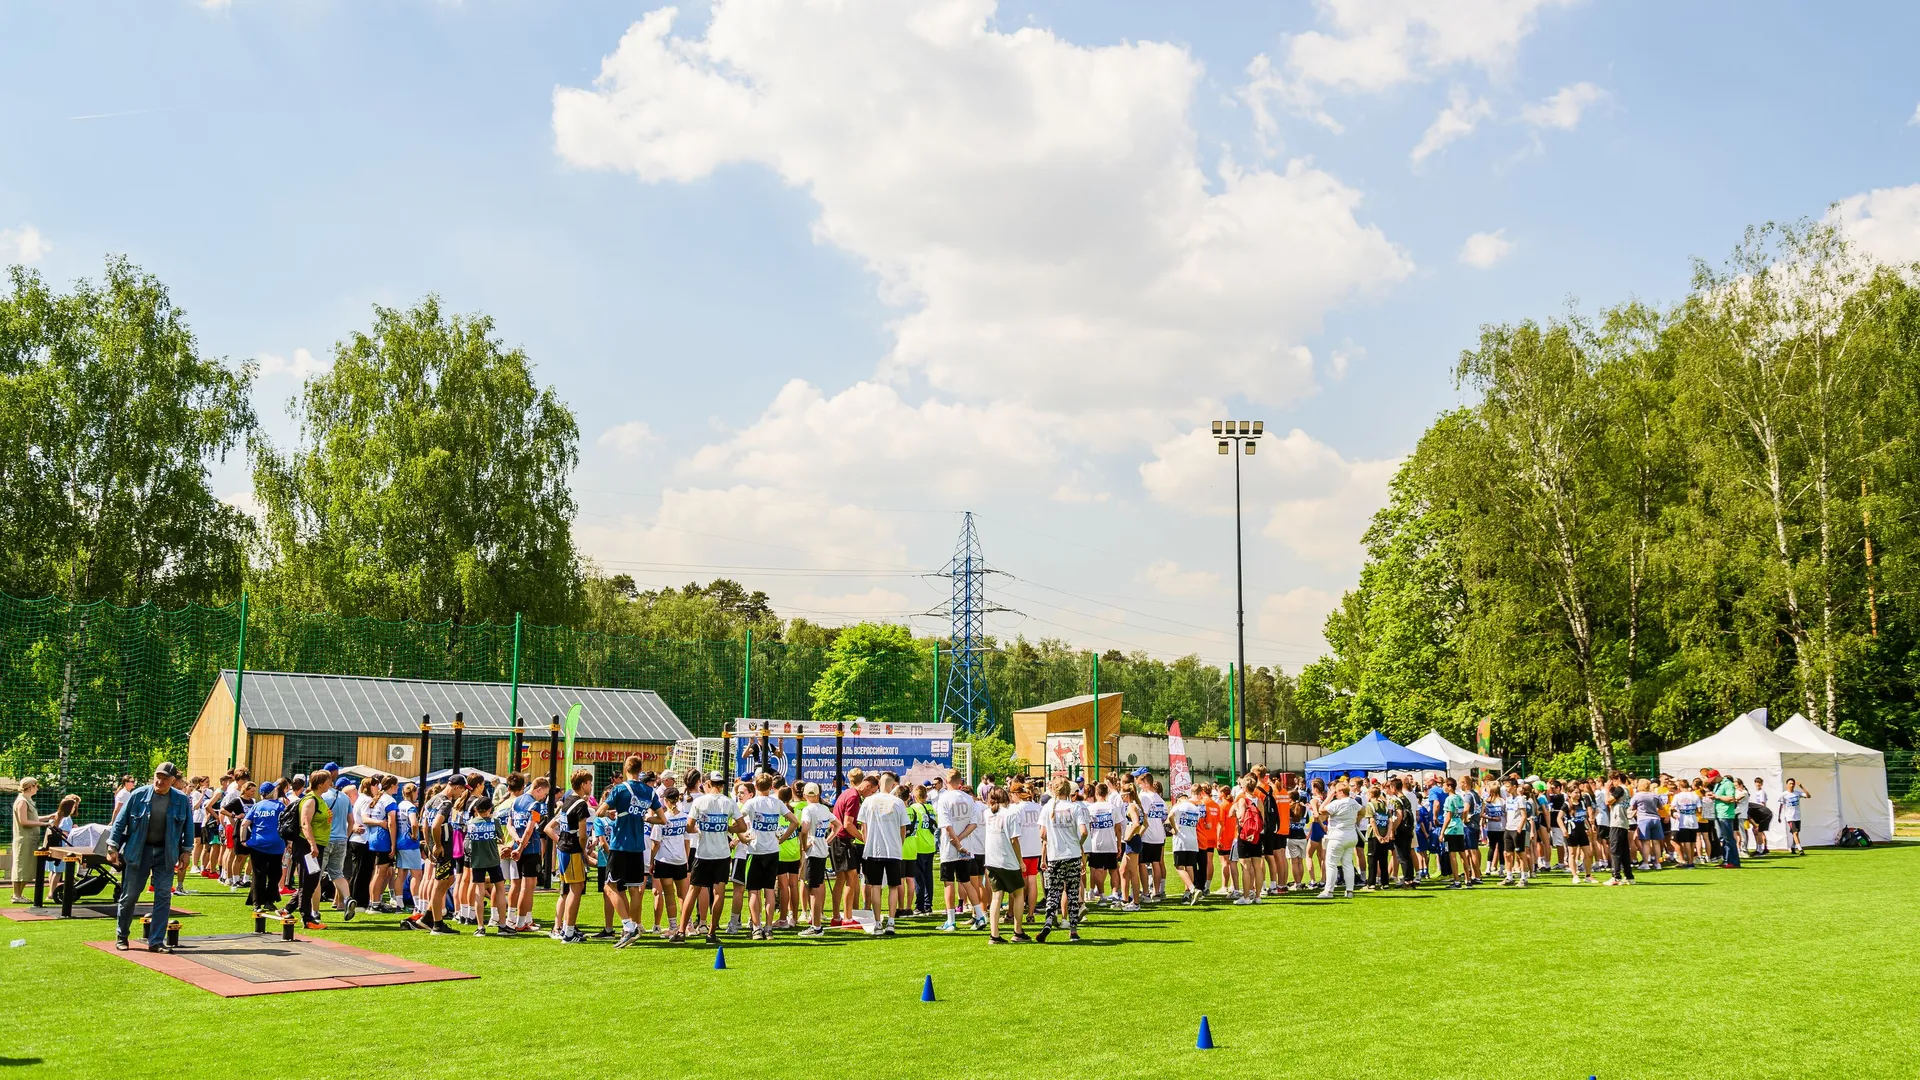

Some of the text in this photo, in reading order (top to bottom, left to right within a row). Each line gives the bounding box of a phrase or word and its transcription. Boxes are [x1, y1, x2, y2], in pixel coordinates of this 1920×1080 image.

[802, 745, 899, 755] ЕТНИЙ ФЕСТАЛЬ ВСЕРОССИЙСКОГО
[792, 757, 904, 767] ФЗКУЛЬТУРНО-ПОРТИВНОГО КОМПЛЕКСА
[628, 805, 646, 816] 08-0
[700, 823, 726, 831] 19-07
[754, 822, 777, 831] 19-08
[1180, 818, 1197, 827] 12-0
[663, 826, 686, 836] 19-01
[469, 832, 495, 841] 02-05
